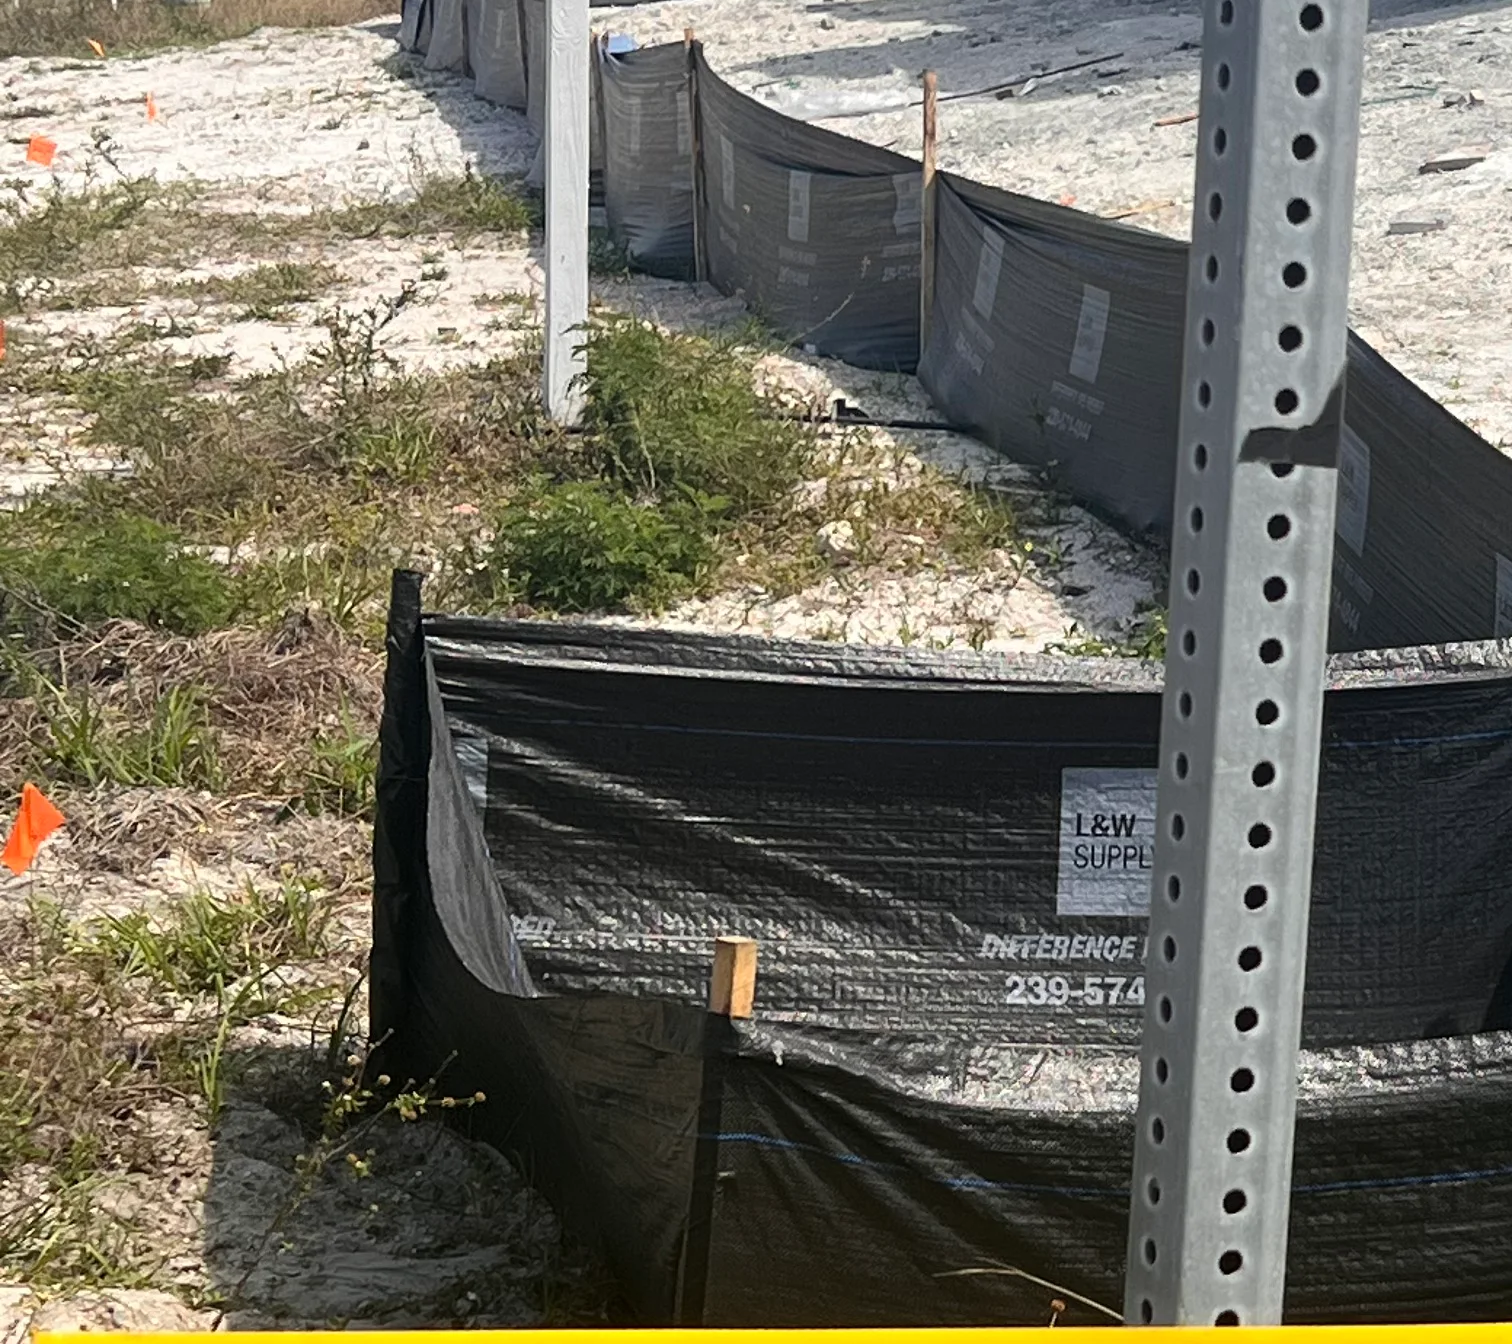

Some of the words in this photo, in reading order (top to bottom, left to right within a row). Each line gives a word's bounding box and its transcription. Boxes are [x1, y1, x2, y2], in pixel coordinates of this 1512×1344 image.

[1075, 813, 1137, 838] L&W
[1073, 844, 1155, 869] SUPPL
[982, 935, 1138, 961] DIFFERENCE
[1005, 975, 1146, 1005] 239-574
